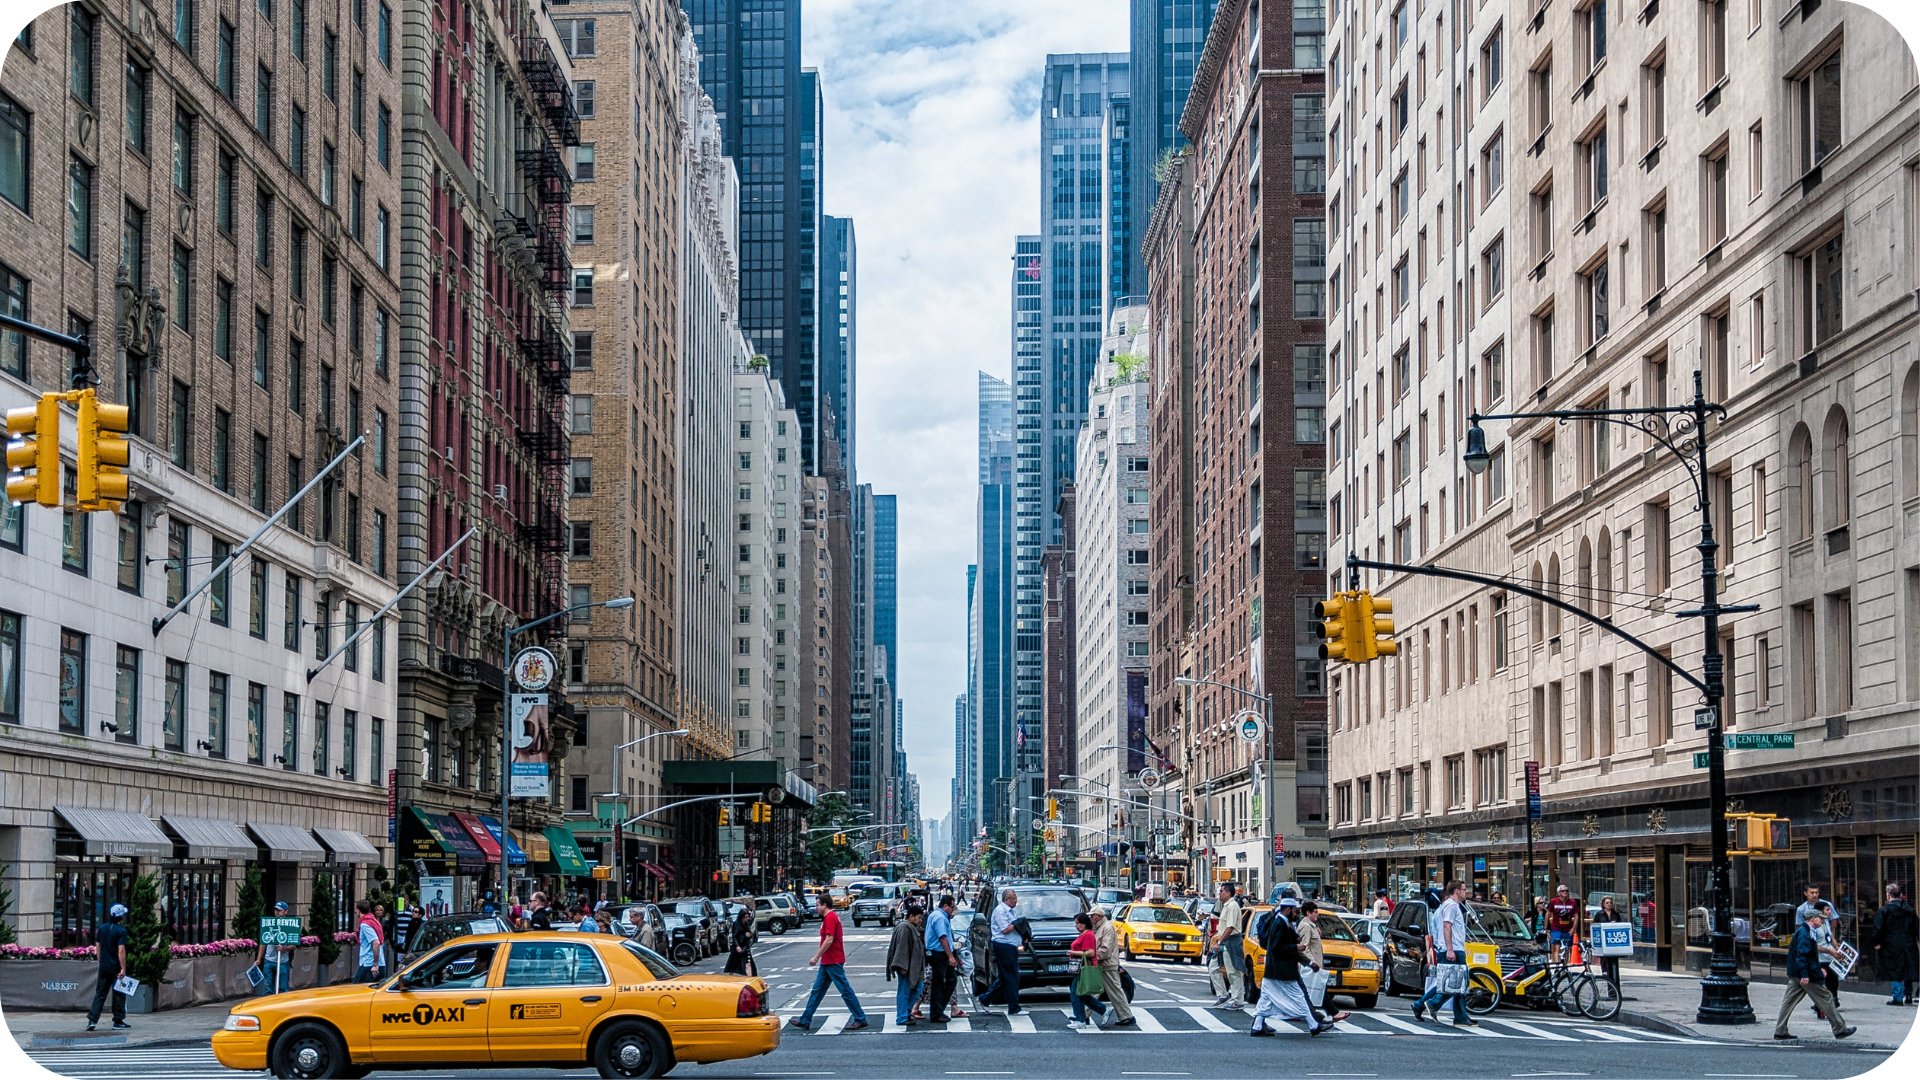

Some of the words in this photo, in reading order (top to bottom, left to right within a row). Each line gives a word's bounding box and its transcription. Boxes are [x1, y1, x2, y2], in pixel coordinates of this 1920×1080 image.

[1737, 735, 1771, 744] CENTRAL
[1773, 734, 1793, 744] PARK
[113, 843, 136, 855] MARKET
[262, 918, 276, 928] BIKE
[276, 918, 300, 928] RENTAL
[41, 981, 79, 990] MARKET
[382, 1013, 412, 1024] NYC
[412, 1004, 464, 1026] TAXI
